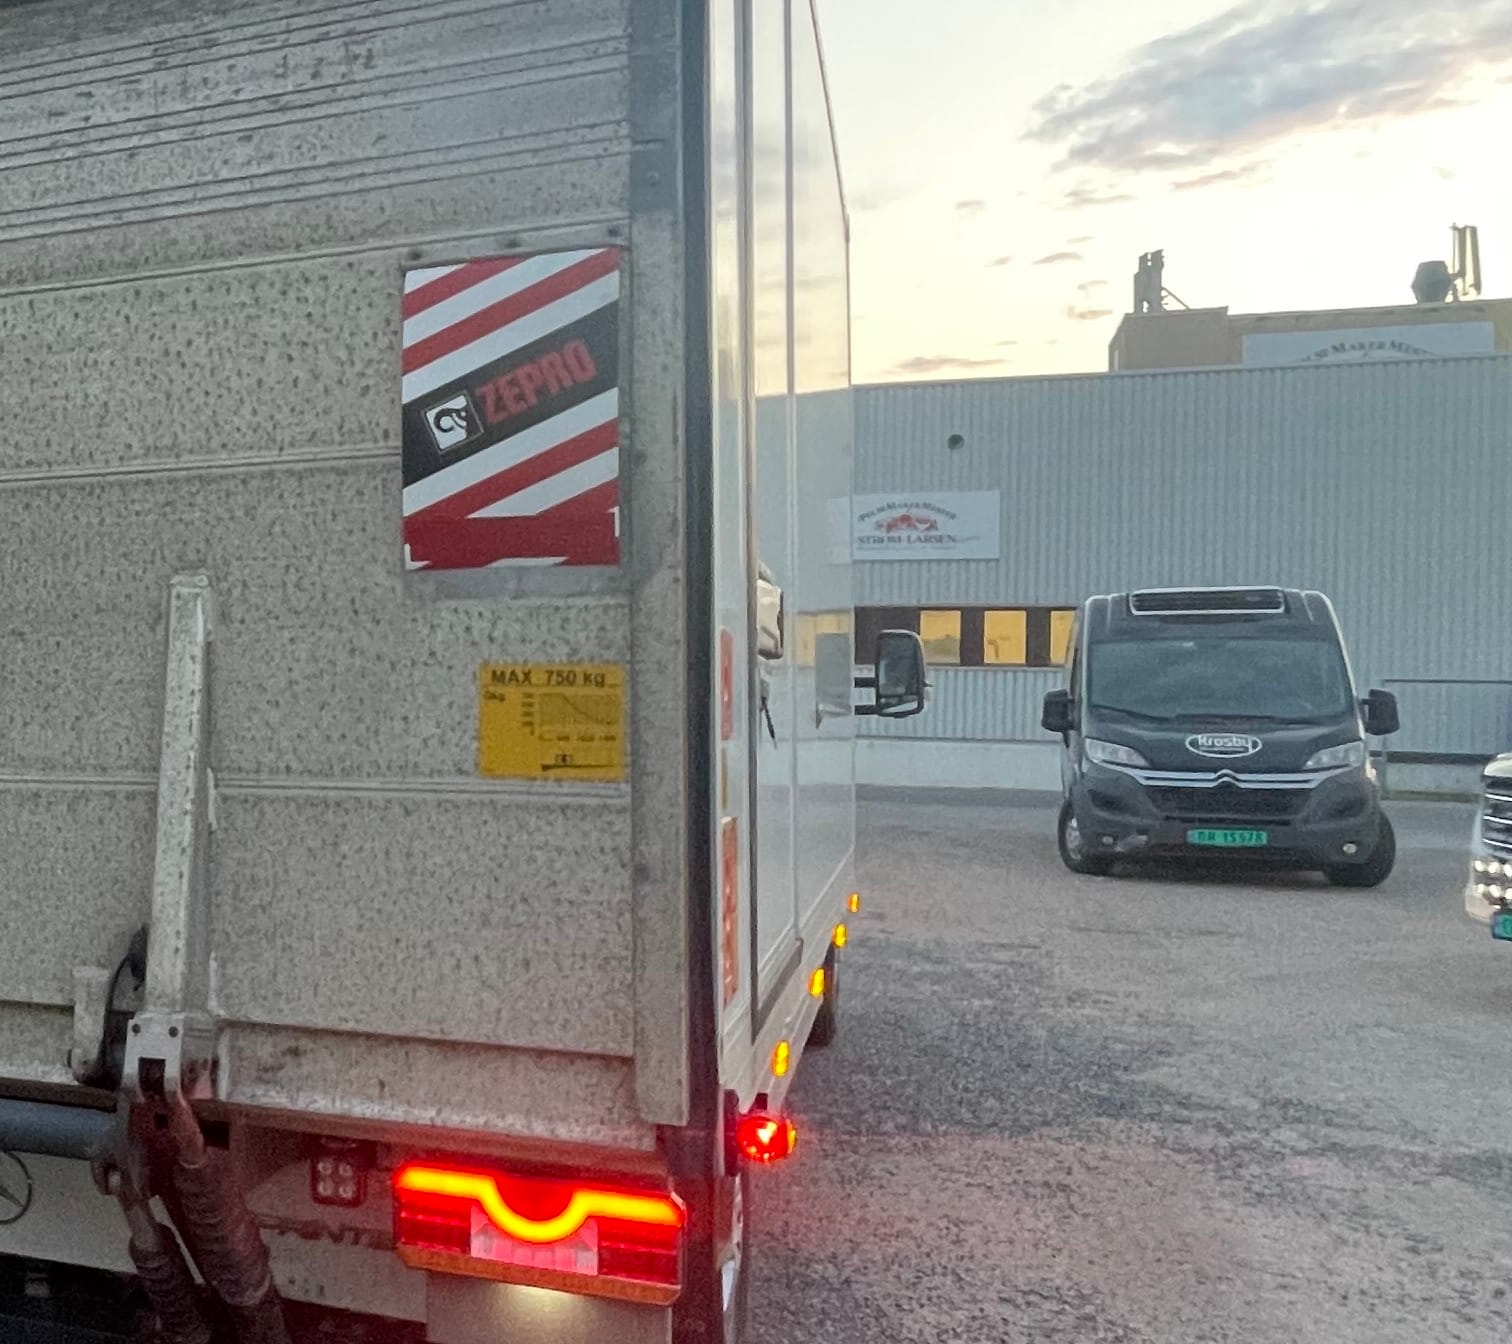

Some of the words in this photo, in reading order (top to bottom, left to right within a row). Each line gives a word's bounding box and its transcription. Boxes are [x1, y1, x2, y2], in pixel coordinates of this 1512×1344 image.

[476, 338, 597, 424] ZEPRO
[491, 669, 533, 685] MAX
[545, 669, 577, 685] 750
[583, 670, 606, 688] kg
